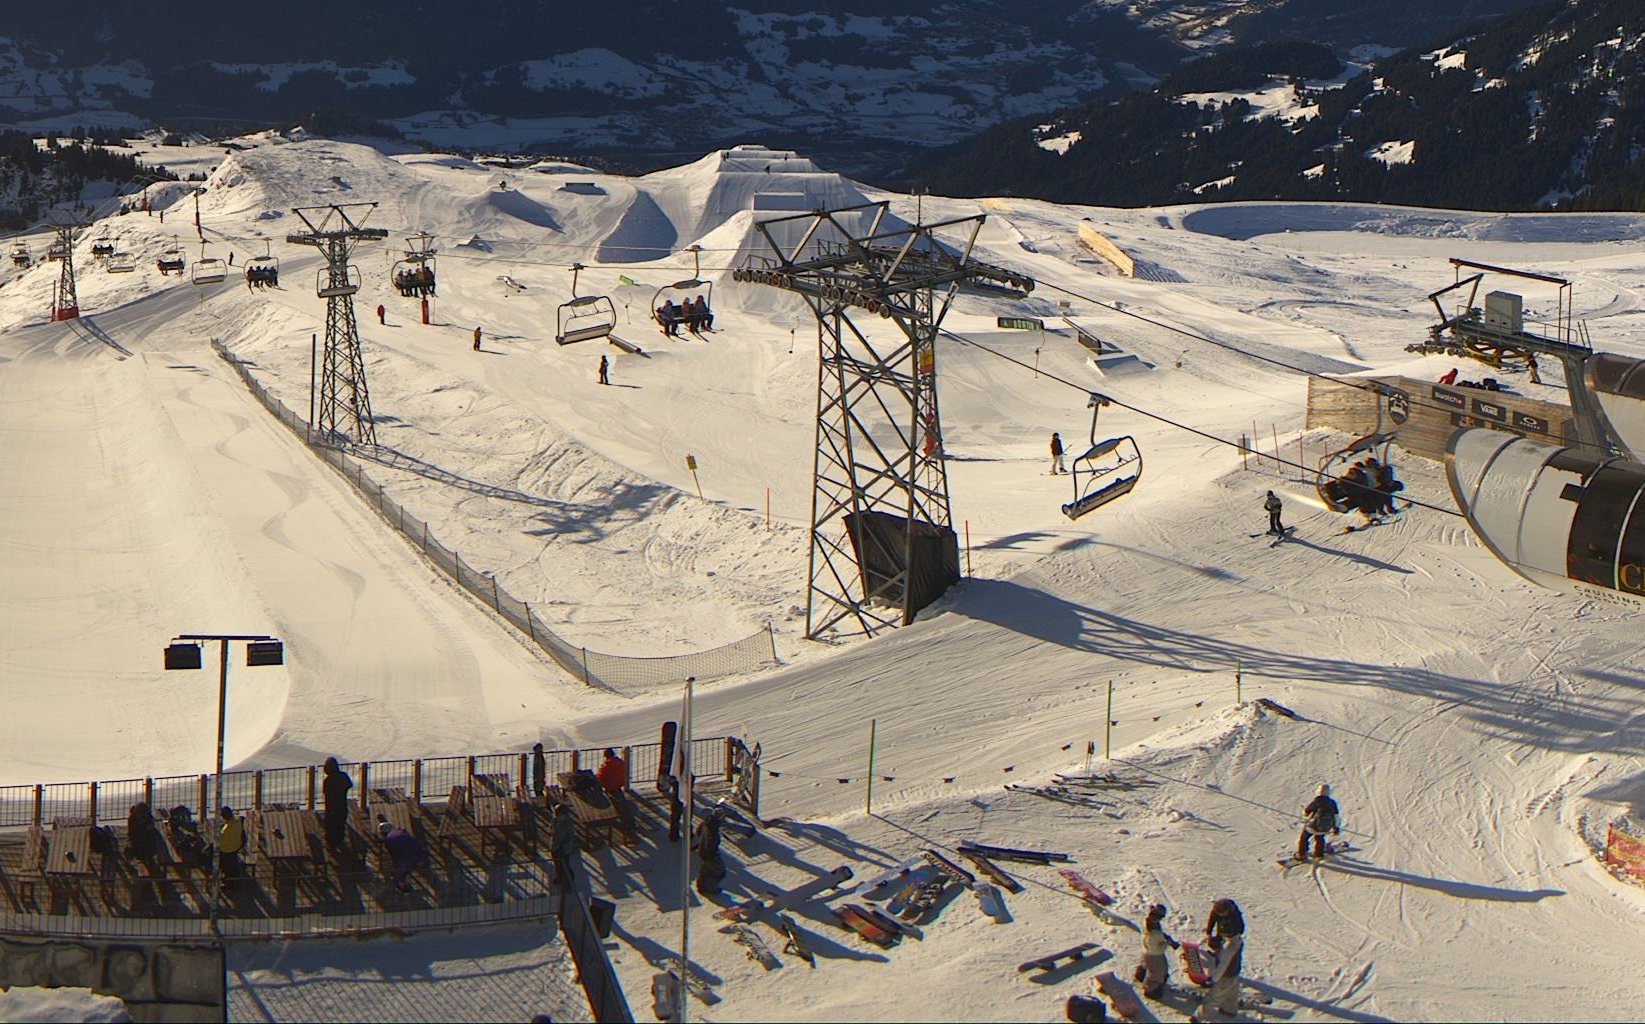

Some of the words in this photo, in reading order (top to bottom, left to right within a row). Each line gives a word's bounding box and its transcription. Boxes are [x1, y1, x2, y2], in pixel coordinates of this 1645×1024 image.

[1480, 403, 1499, 416] VANS
[1574, 584, 1642, 606] CRUISING
[920, 852, 966, 884] SALOMON
